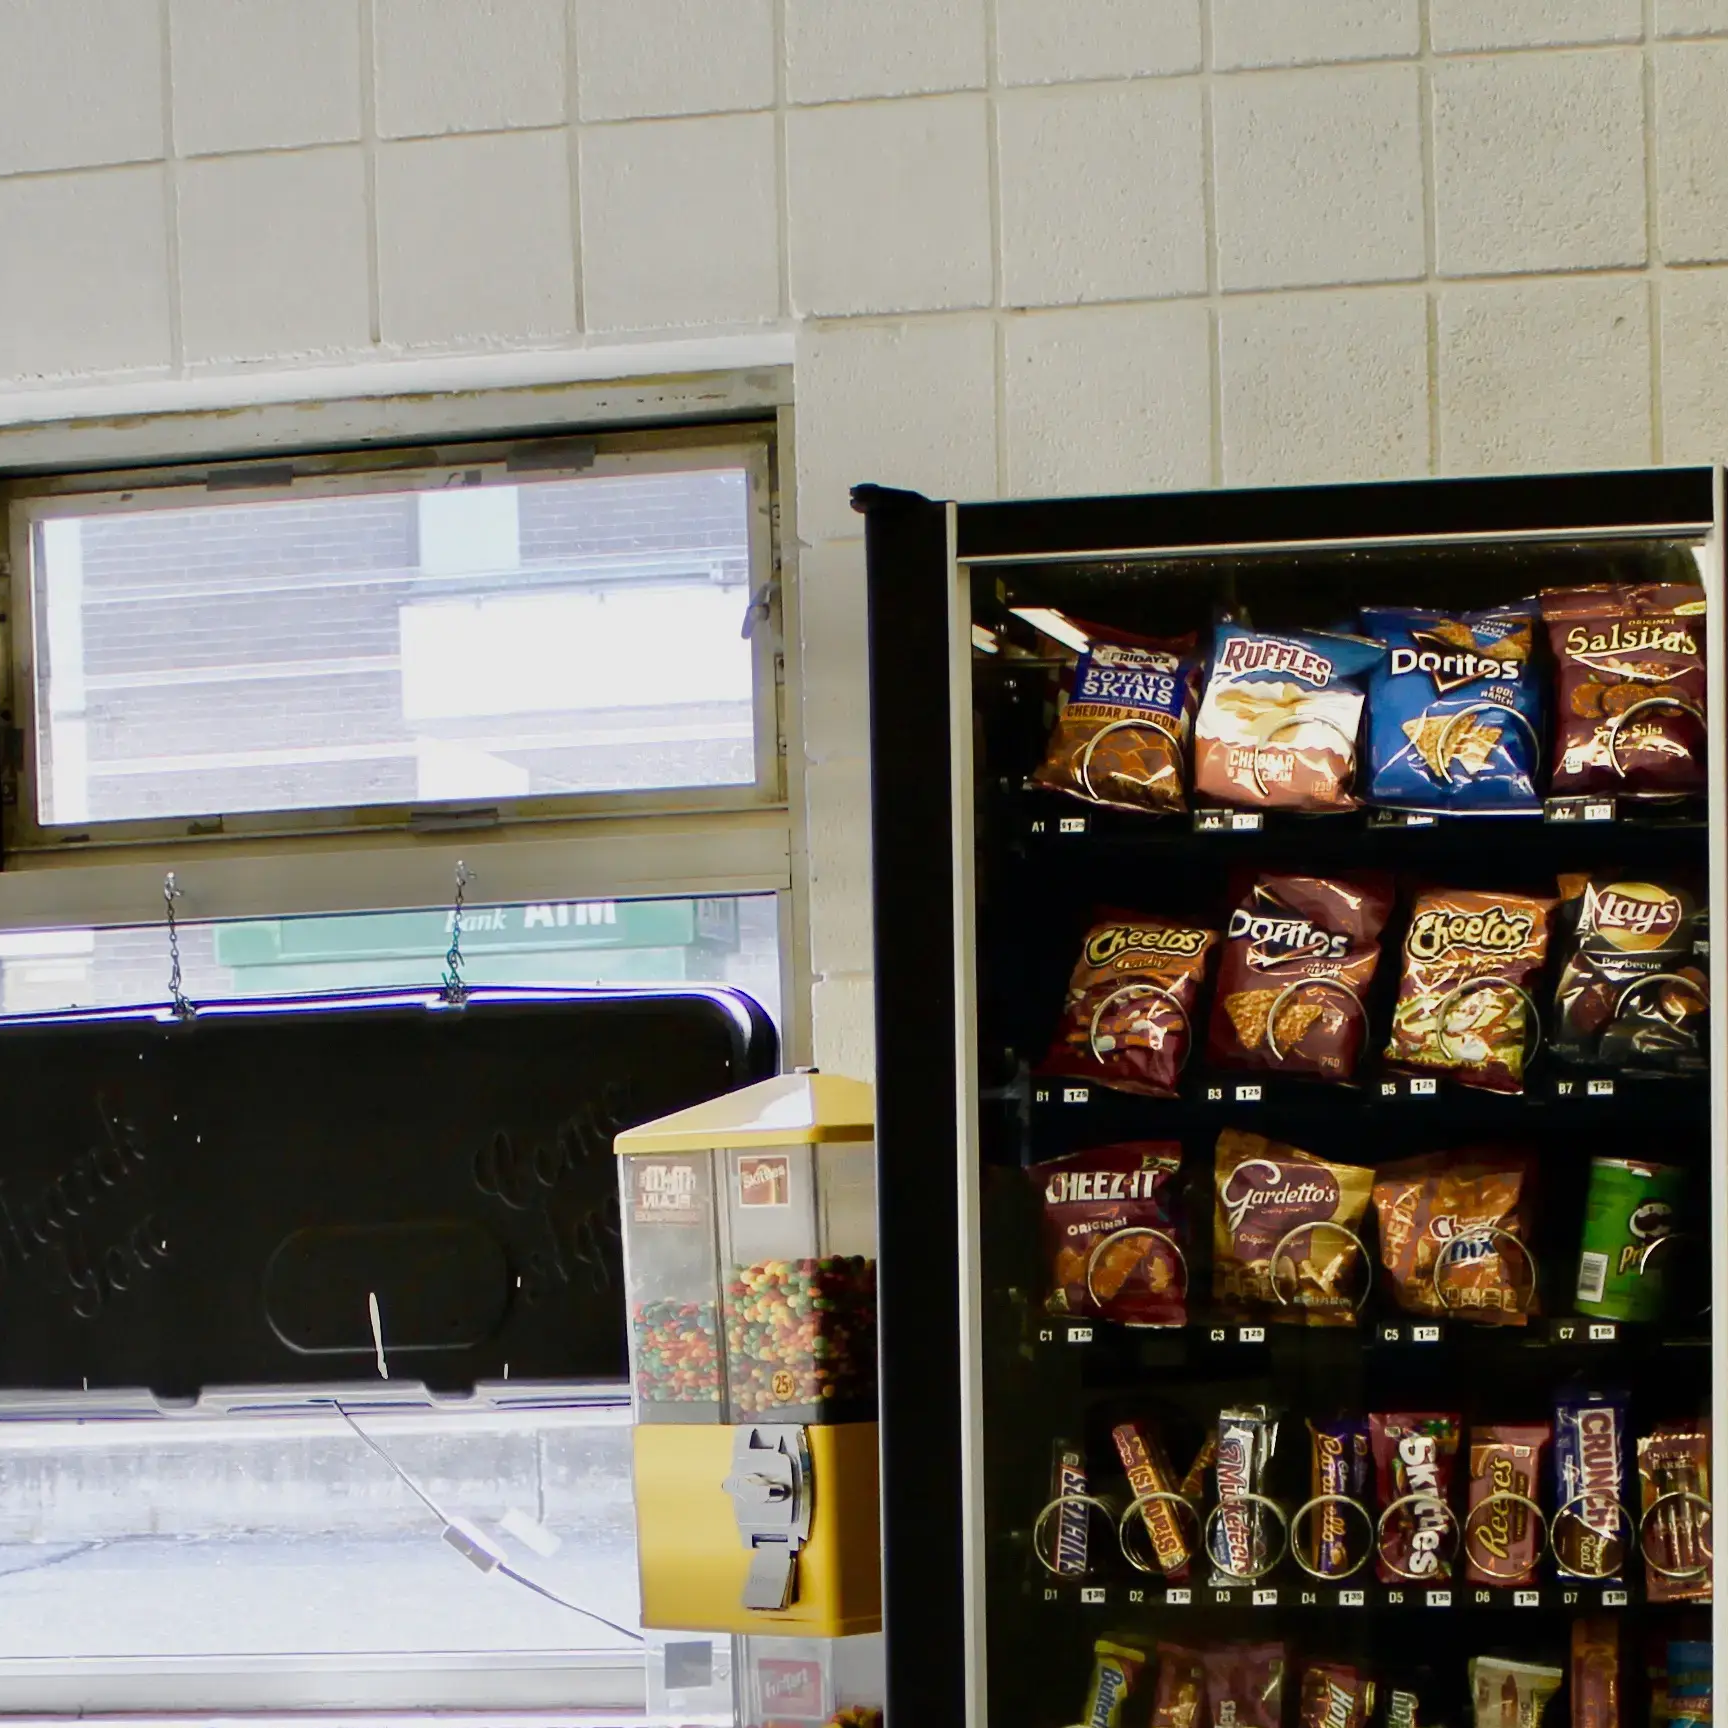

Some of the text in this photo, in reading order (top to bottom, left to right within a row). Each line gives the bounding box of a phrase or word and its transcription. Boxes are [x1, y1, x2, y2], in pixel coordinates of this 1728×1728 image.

[1225, 638, 1333, 687] RUFFLES
[1391, 649, 1519, 681] Doritos
[1085, 669, 1175, 690] POTATO
[1082, 682, 1173, 705] SKINS
[1066, 704, 1177, 730] CHEDDAR & BACON
[1555, 808, 1569, 819] A7
[1032, 822, 1045, 832] A1
[1204, 817, 1219, 828] A3
[523, 902, 618, 929] ATM
[1599, 898, 1674, 935] Lay's
[1228, 910, 1348, 958] Doritos
[1411, 906, 1532, 957] Cheetos
[1088, 927, 1206, 964] Cheetos
[1601, 957, 1662, 971] Barbecue
[1208, 1088, 1222, 1099] B3
[1382, 1083, 1396, 1094] B5
[1558, 1083, 1572, 1094] B7
[1037, 1090, 1049, 1102] B1
[1045, 1169, 1159, 1203] CHEEZ-IT
[1223, 1159, 1337, 1218] Gardetto's
[1040, 1331, 1052, 1342] C1
[1211, 1330, 1225, 1341] C3
[1385, 1329, 1399, 1340] C5
[1560, 1328, 1574, 1339] C7
[1581, 1411, 1618, 1530] CRUNCH
[1045, 1589, 1057, 1600] D1
[1130, 1591, 1144, 1602] D2
[1217, 1591, 1230, 1602] D3
[1302, 1593, 1316, 1604] D4
[1389, 1592, 1403, 1603] D5
[1476, 1592, 1490, 1602] D6
[1564, 1592, 1578, 1603] D7
